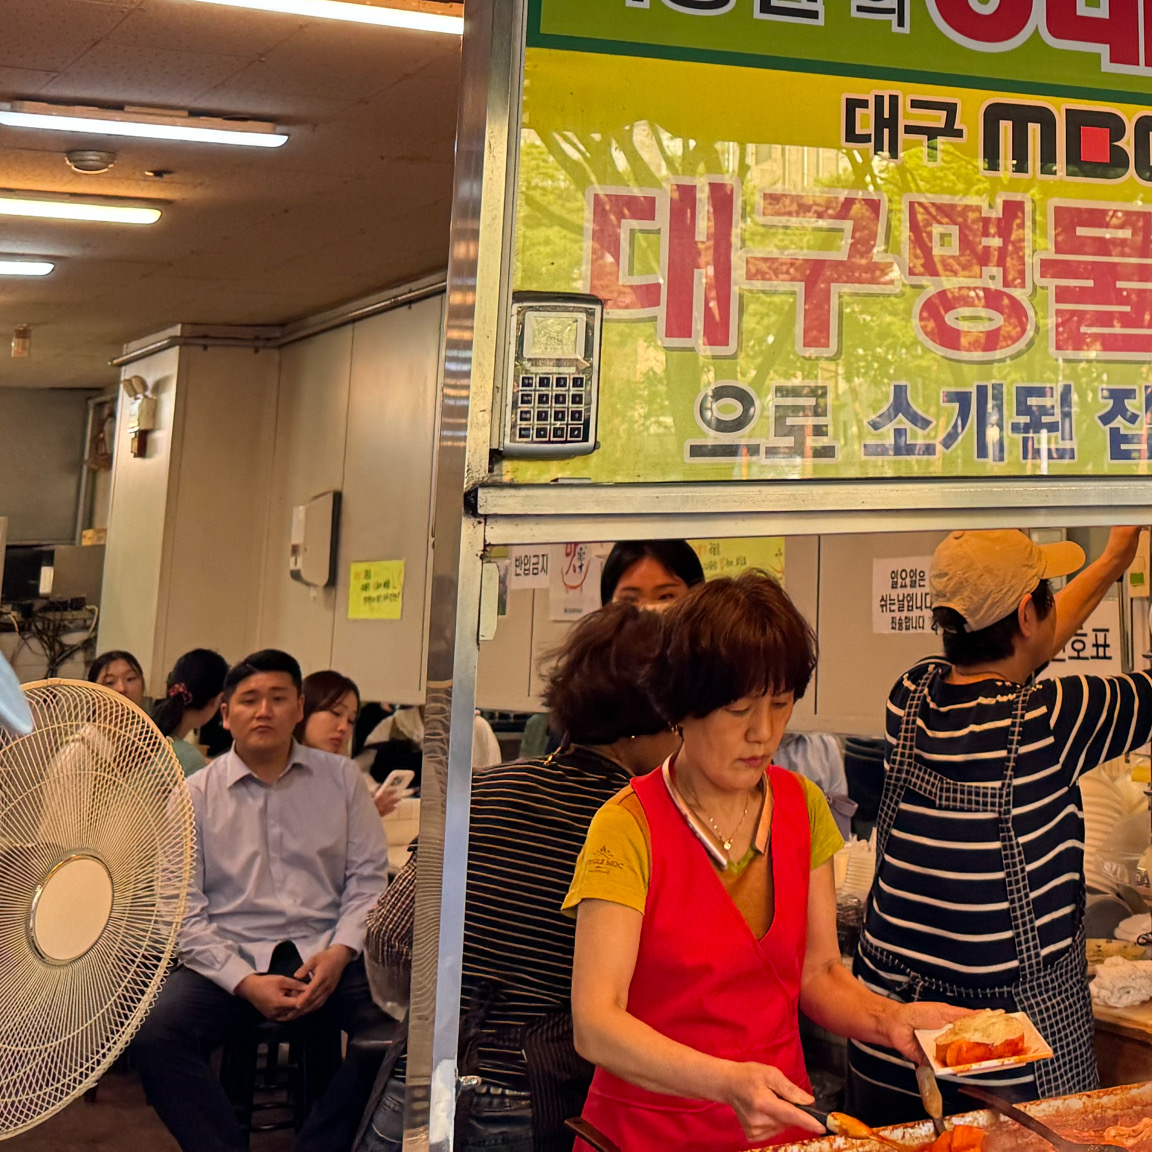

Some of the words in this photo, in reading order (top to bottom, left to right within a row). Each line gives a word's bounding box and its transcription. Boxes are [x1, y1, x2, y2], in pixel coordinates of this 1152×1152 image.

[841, 89, 967, 165] 대구
[684, 380, 840, 464] 으로
[862, 380, 1077, 464] 소개된
[514, 552, 549, 577] 반입금지
[890, 568, 926, 589] 일요일은
